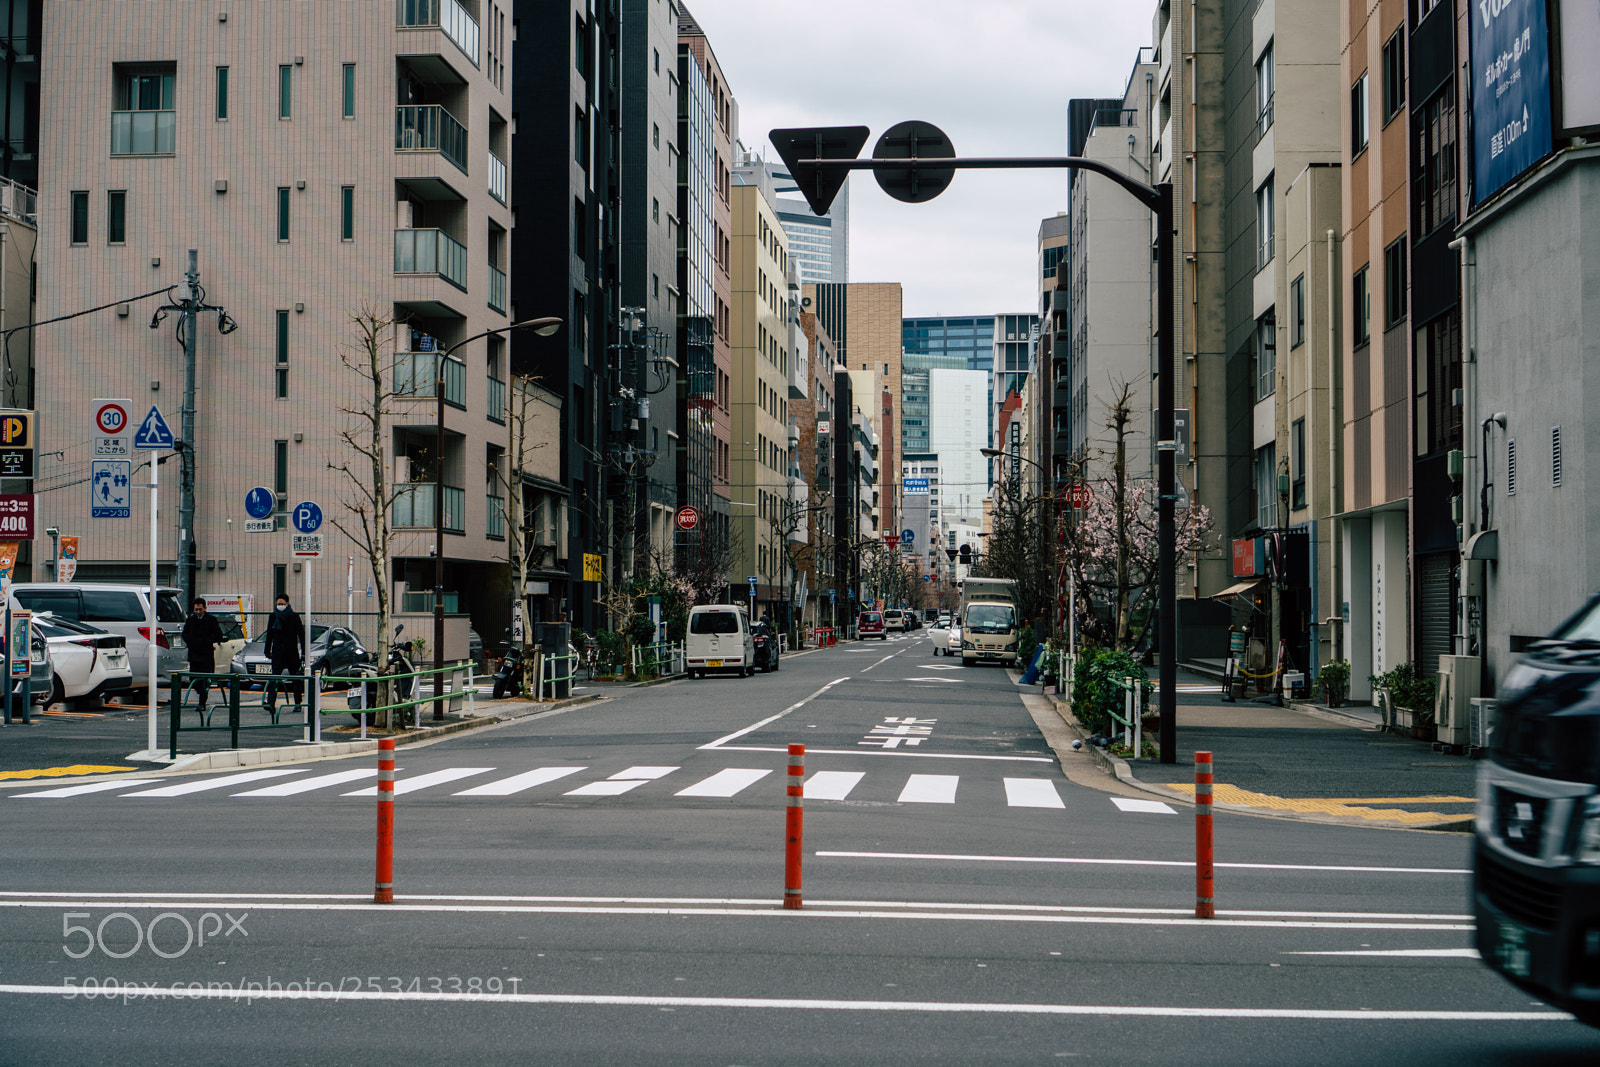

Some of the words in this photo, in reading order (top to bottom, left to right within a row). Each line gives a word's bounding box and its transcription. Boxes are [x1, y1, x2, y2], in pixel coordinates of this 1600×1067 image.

[1490, 120, 1521, 160] 直進100m
[103, 412, 121, 425] 30
[2, 452, 24, 473] 空
[245, 522, 272, 530] 歩行者優先
[299, 509, 311, 528] P
[679, 514, 697, 523] 消火栓
